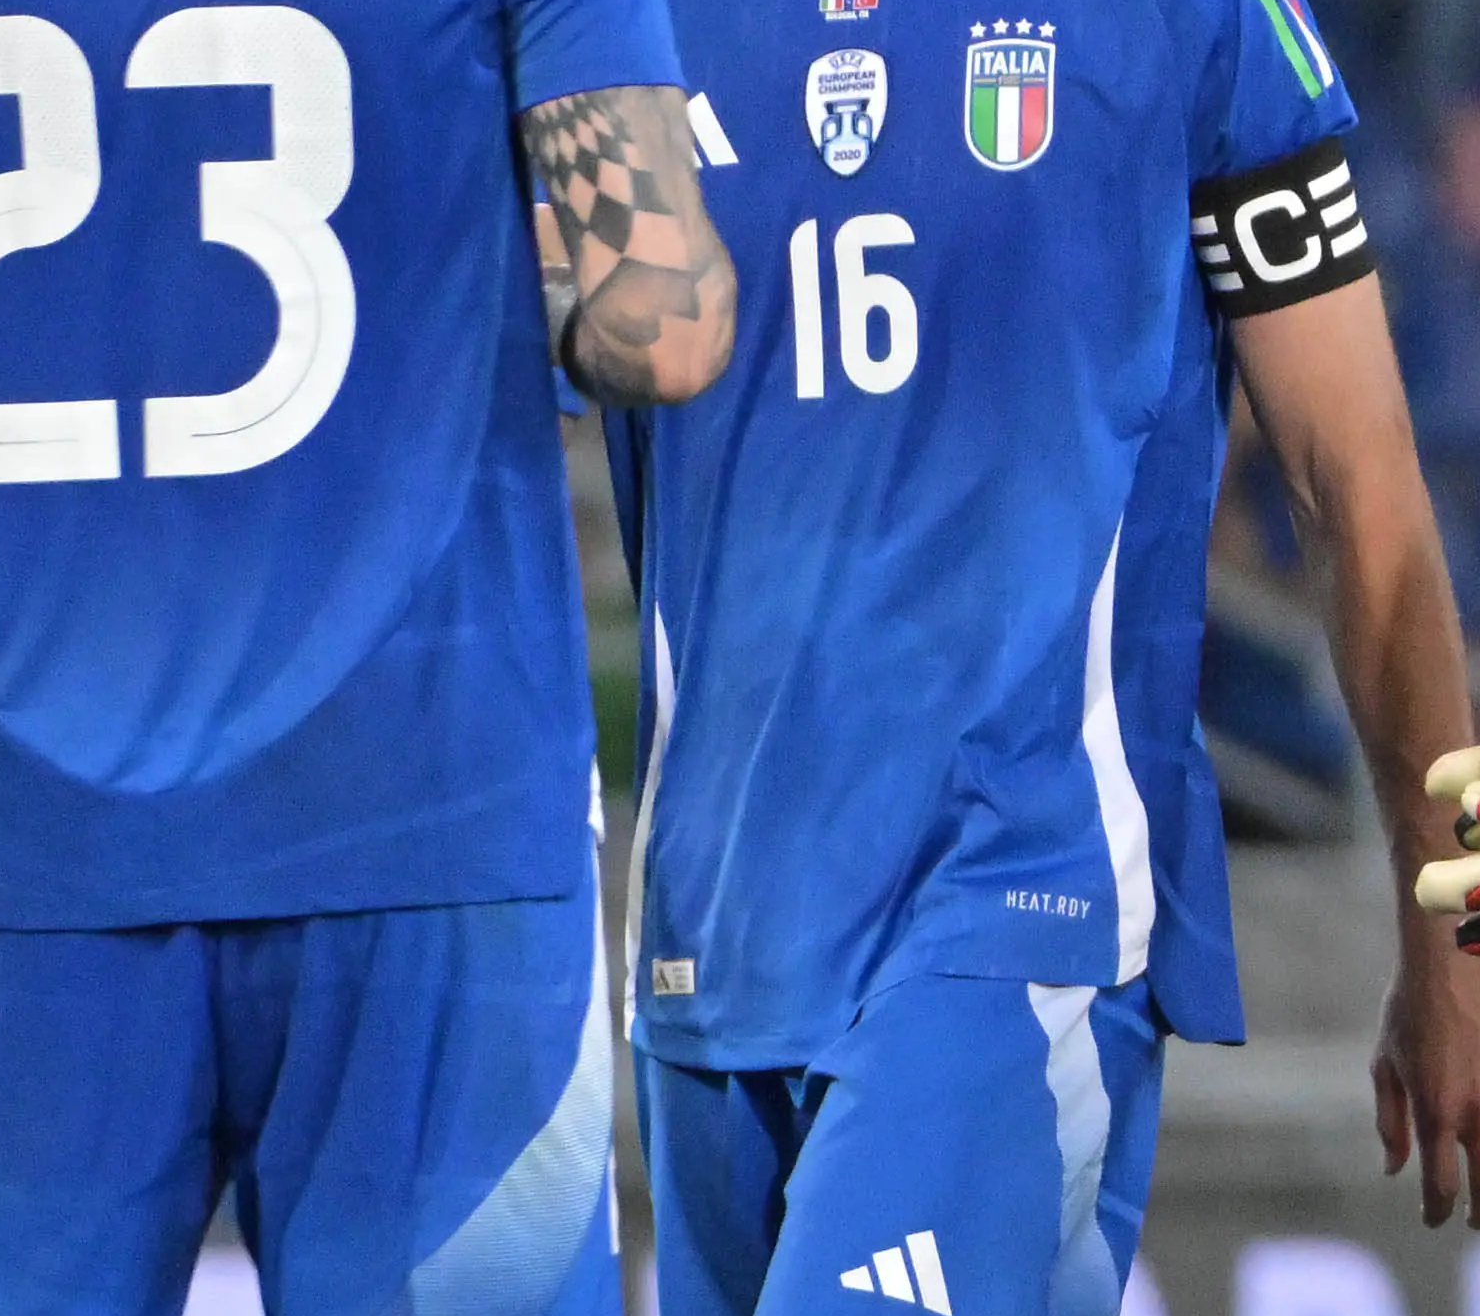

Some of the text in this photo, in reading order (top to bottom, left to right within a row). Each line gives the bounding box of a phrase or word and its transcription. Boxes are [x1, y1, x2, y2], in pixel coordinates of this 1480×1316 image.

[973, 49, 1047, 76] ITALIA
[818, 69, 876, 84] EUROPEAN
[818, 81, 876, 95] CHAMPIONS
[832, 148, 862, 162] 2020
[789, 212, 920, 400] 16
[1005, 890, 1092, 920] HEAT.RDY
